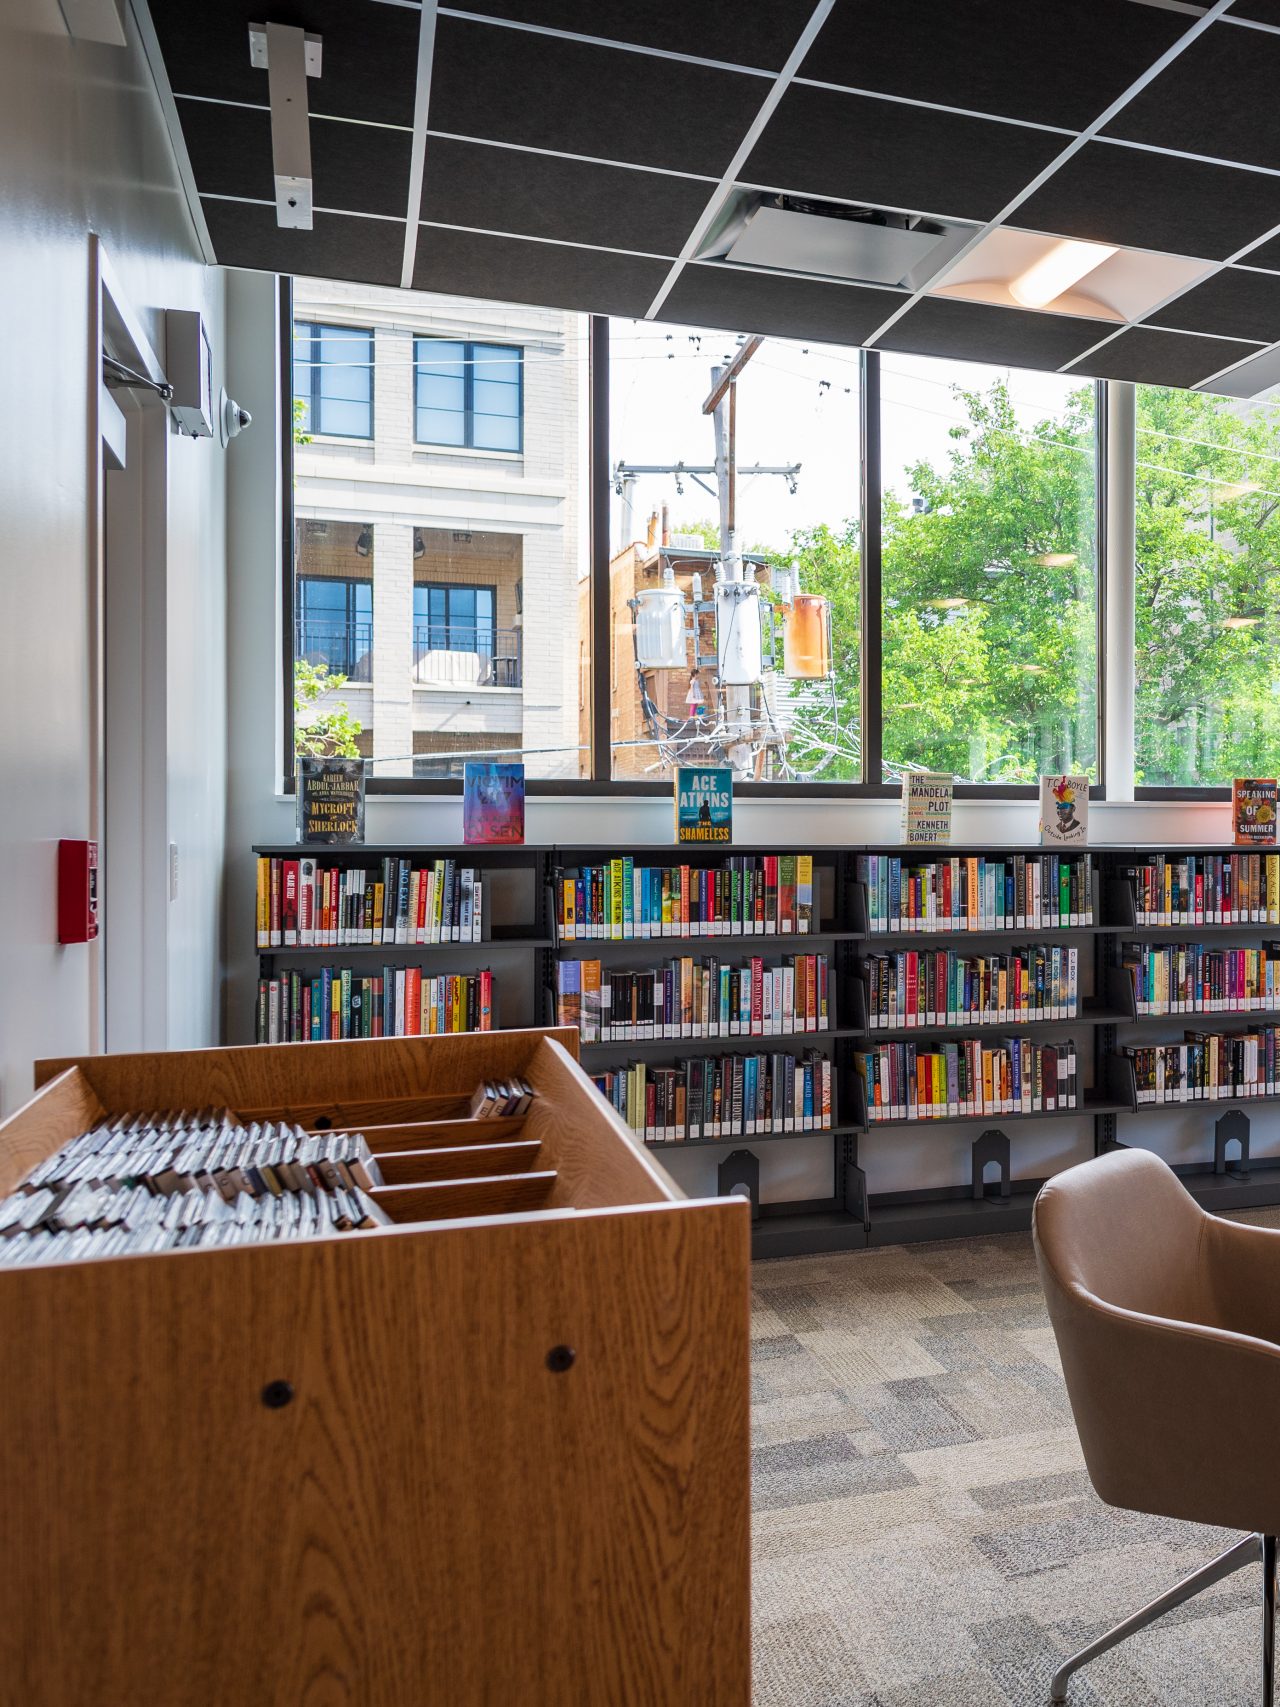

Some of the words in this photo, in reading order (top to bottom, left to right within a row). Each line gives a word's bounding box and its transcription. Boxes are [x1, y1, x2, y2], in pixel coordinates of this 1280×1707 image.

[308, 780, 359, 792] ABDUL-JABBAR
[466, 776, 524, 788] VICTIM
[692, 776, 717, 790] ACE
[1066, 780, 1088, 792] BOYLE
[912, 788, 949, 798] MANDELA
[1236, 790, 1276, 798] SPEAKING
[680, 792, 729, 808] ATKINS
[312, 802, 354, 815] MYCROFT
[928, 802, 950, 812] PLOT
[1246, 806, 1258, 816] OF
[309, 820, 358, 832] SHERLOCK
[468, 825, 524, 838] OLSEN
[917, 821, 948, 829] KENNETH
[1240, 824, 1274, 832] SUMMER
[680, 828, 728, 840] SHAMELESS
[910, 833, 937, 842] BONERT
[400, 869, 408, 882] NO
[1270, 858, 1278, 880] DARK
[614, 876, 622, 898] ATKINS
[1270, 881, 1278, 898] AGE
[400, 888, 408, 910] EXIT
[753, 962, 761, 981] DAVID
[343, 972, 351, 992] GIRLS
[753, 982, 761, 1014] BALDACCI
[732, 1075, 742, 1099] NINTH
